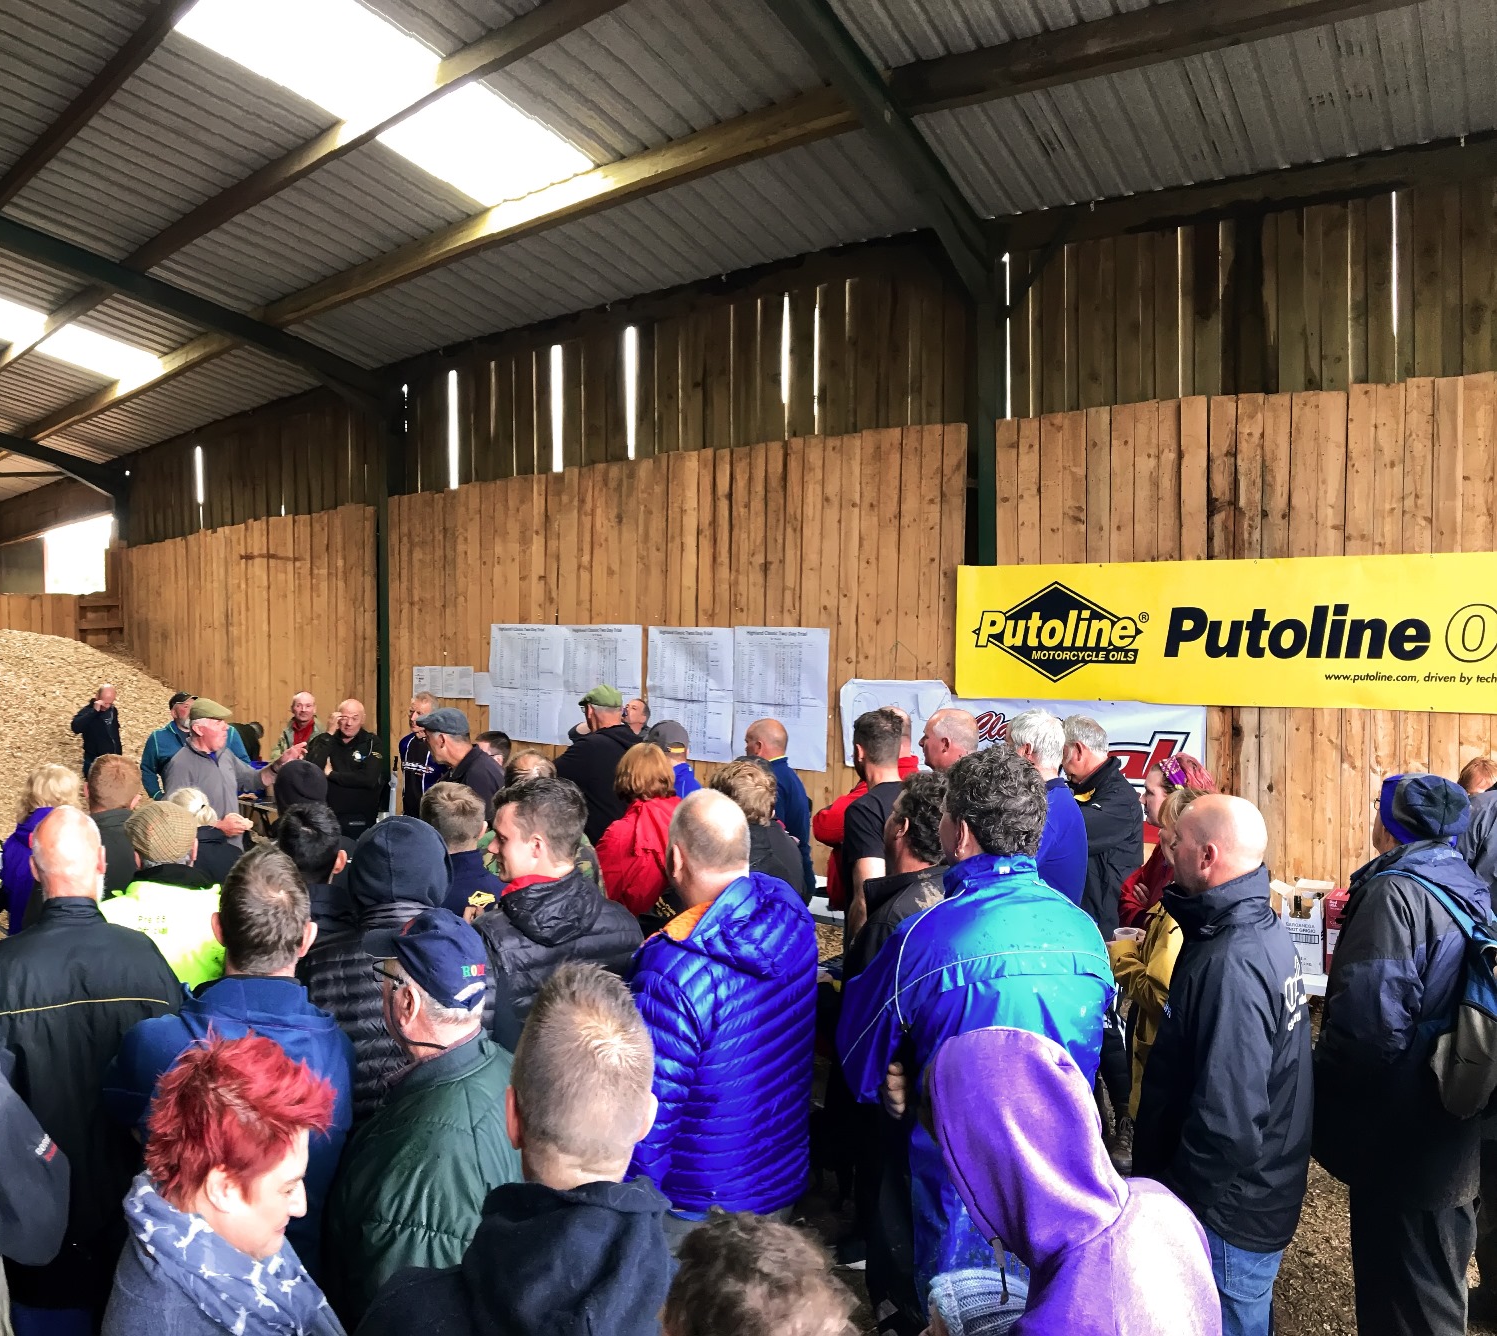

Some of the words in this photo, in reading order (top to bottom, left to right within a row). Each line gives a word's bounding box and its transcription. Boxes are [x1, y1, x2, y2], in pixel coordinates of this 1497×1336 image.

[974, 609, 1138, 648] Putoline
[1164, 603, 1431, 661] Putoline
[1031, 650, 1106, 662] MOTORCYCLE
[1108, 649, 1136, 662] OILS
[1324, 671, 1420, 683] www.putoline.com,
[1423, 672, 1456, 683] driven
[1459, 673, 1473, 685] by
